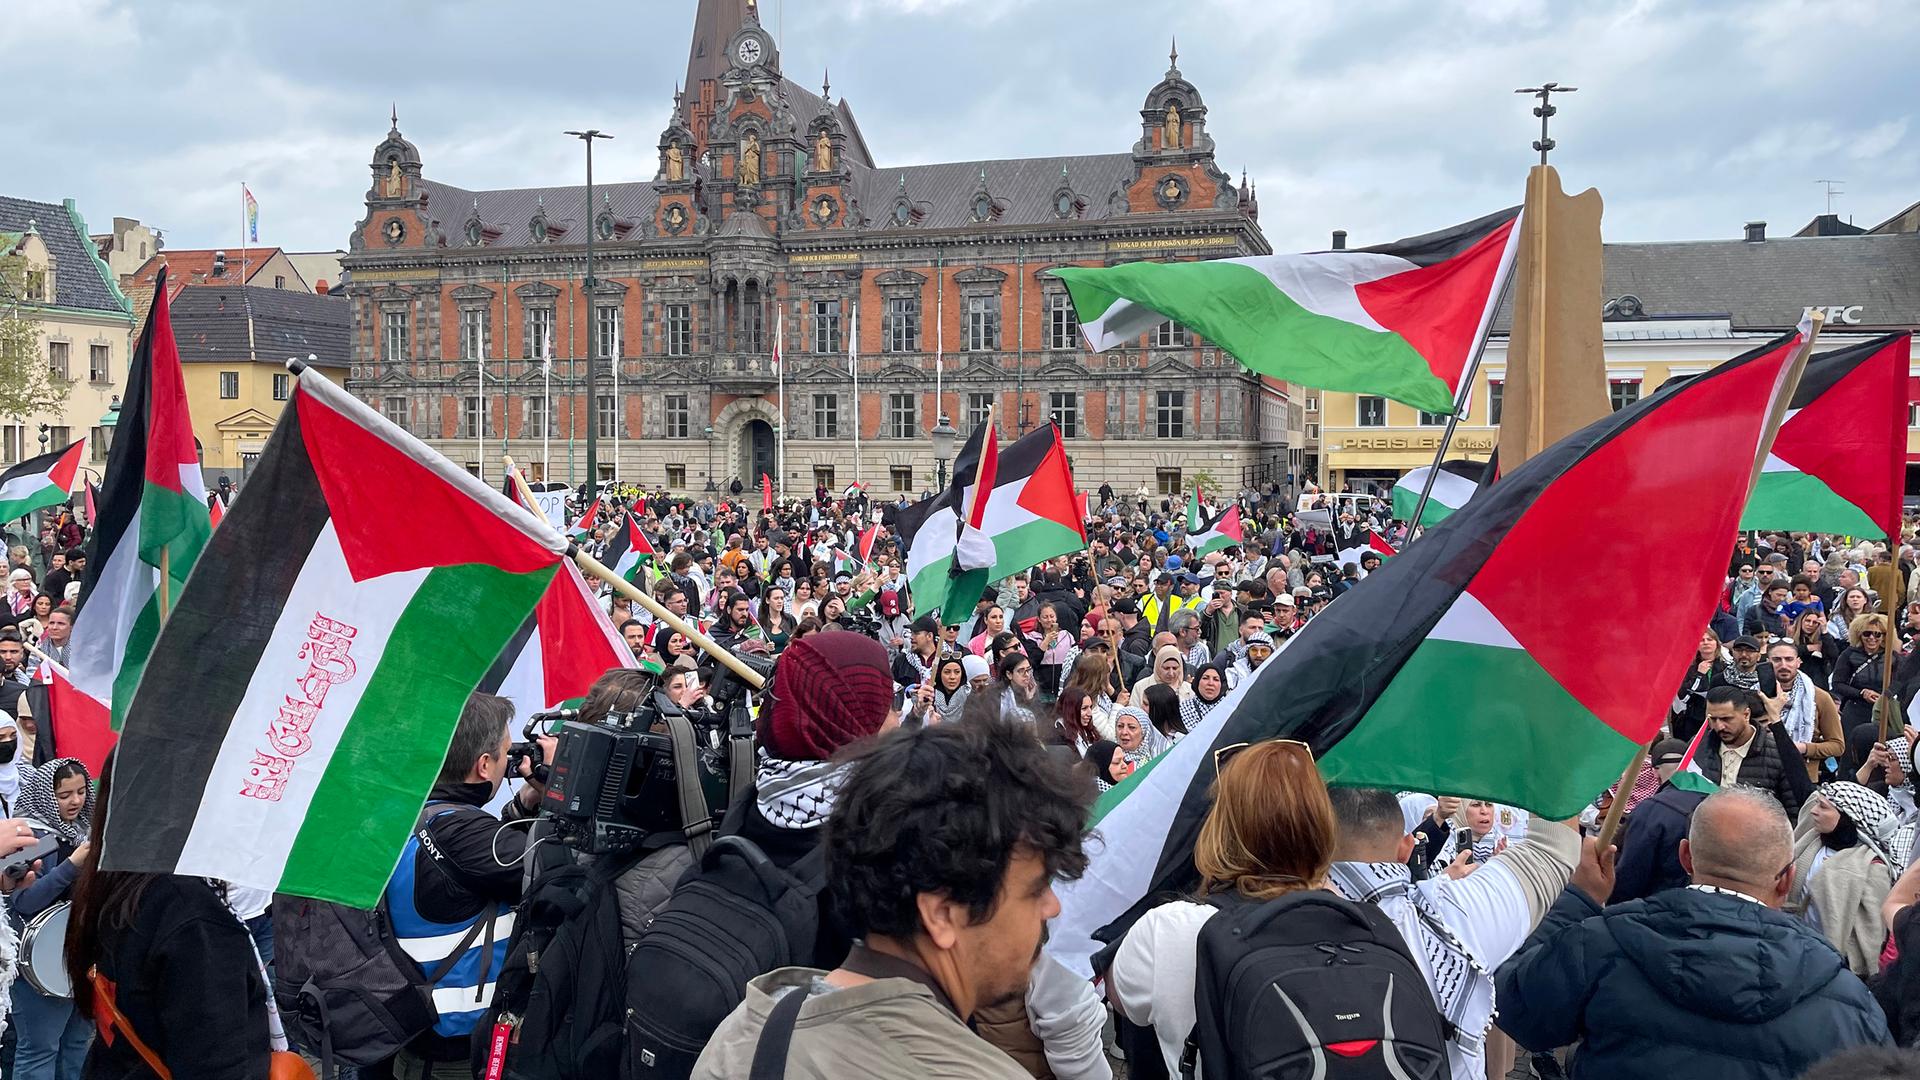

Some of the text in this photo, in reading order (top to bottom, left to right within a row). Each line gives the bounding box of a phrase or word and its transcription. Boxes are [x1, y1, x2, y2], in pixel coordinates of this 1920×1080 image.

[1140, 240, 1152, 248] OCH
[418, 829, 445, 861] SONY
[1335, 1013, 1361, 1021] Targus
